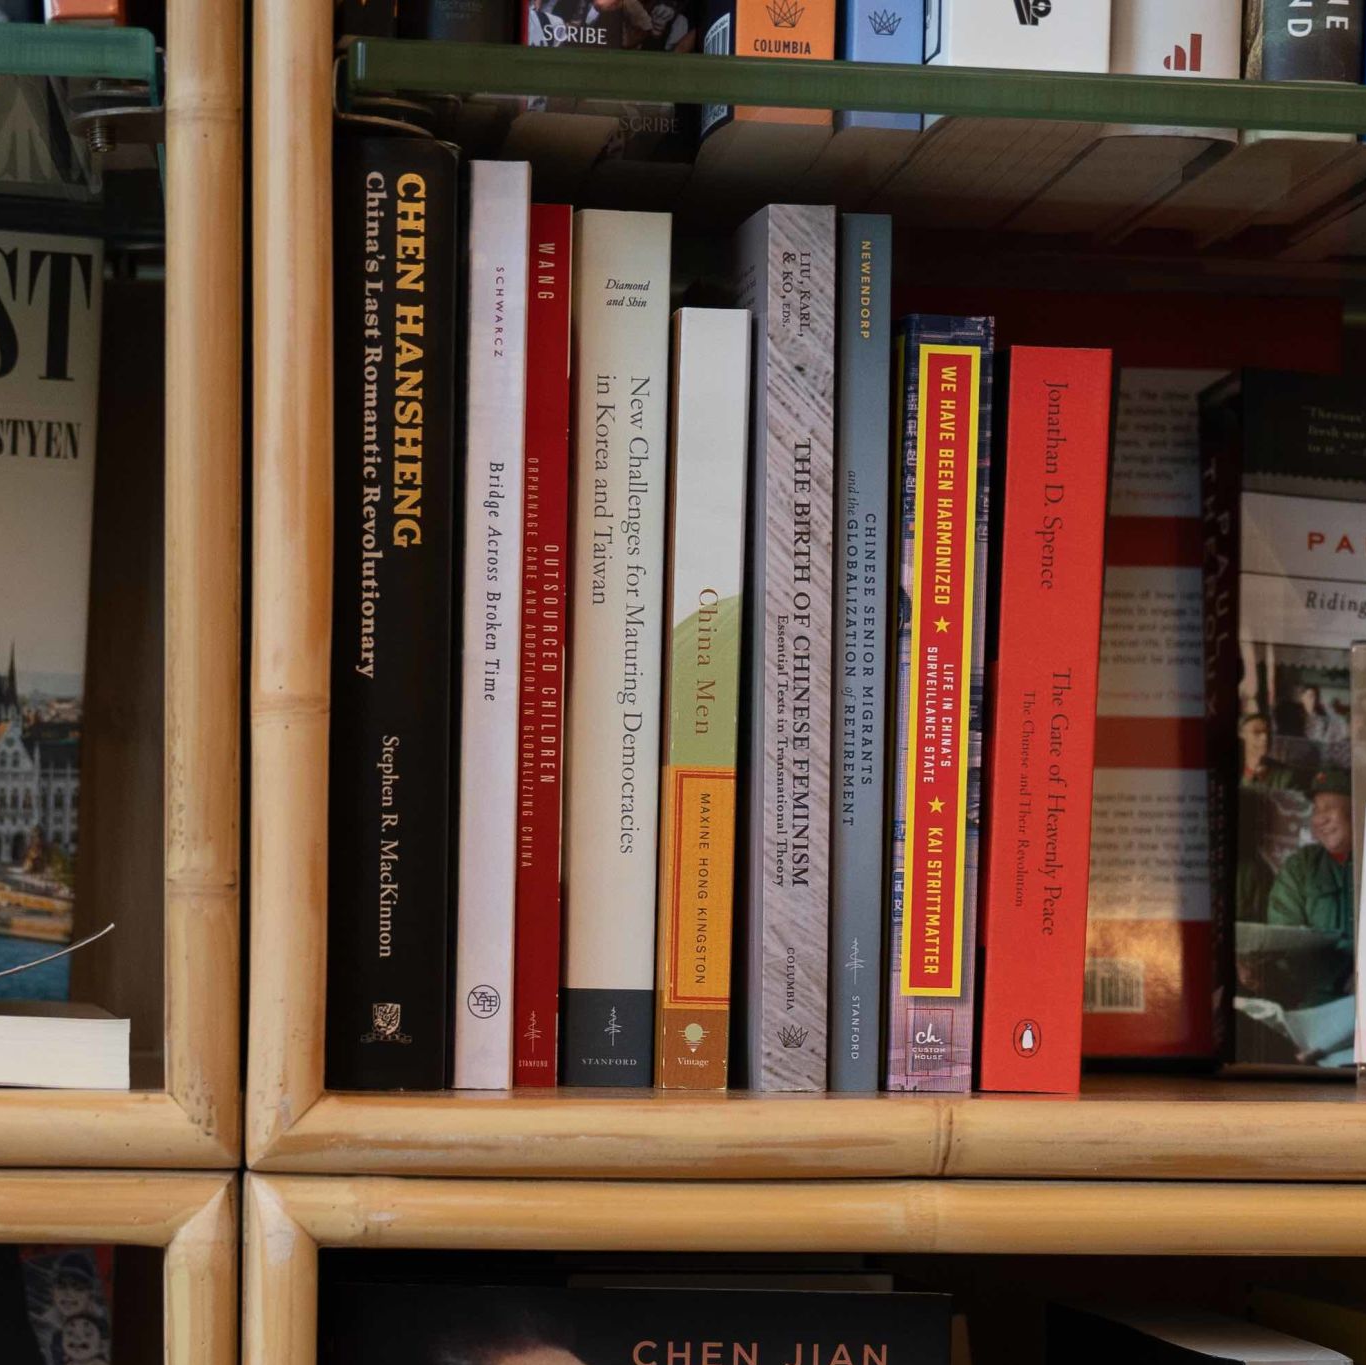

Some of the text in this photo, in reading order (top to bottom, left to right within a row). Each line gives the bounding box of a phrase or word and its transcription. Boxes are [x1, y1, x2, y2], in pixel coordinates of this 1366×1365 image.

[543, 25, 607, 45] SCRIBE
[753, 39, 811, 55] COLUMBIA
[393, 173, 426, 548] CHEN HANSHENG
[861, 240, 871, 340] NEWENDORP
[356, 171, 387, 678] China's Last Romantic Revolutionary
[934, 366, 957, 606] WE HAVE BEEN HARMONIZED
[1034, 380, 1069, 589] Jonathan D. Spence
[484, 461, 505, 702] Bridge Across Broken Time
[540, 544, 560, 784] OUTSOURCED CHILDREN
[617, 376, 650, 856] New Challenges for Maturing Democracies
[694, 588, 719, 736] China Men
[791, 438, 812, 888] THE BIRTH OF CHINESE FEMINISM
[377, 735, 401, 959] Stephen R. MacKinnon
[695, 792, 710, 985] MAXINE HONG KINGSTON
[922, 827, 944, 975] KAI STRITTMATTER
